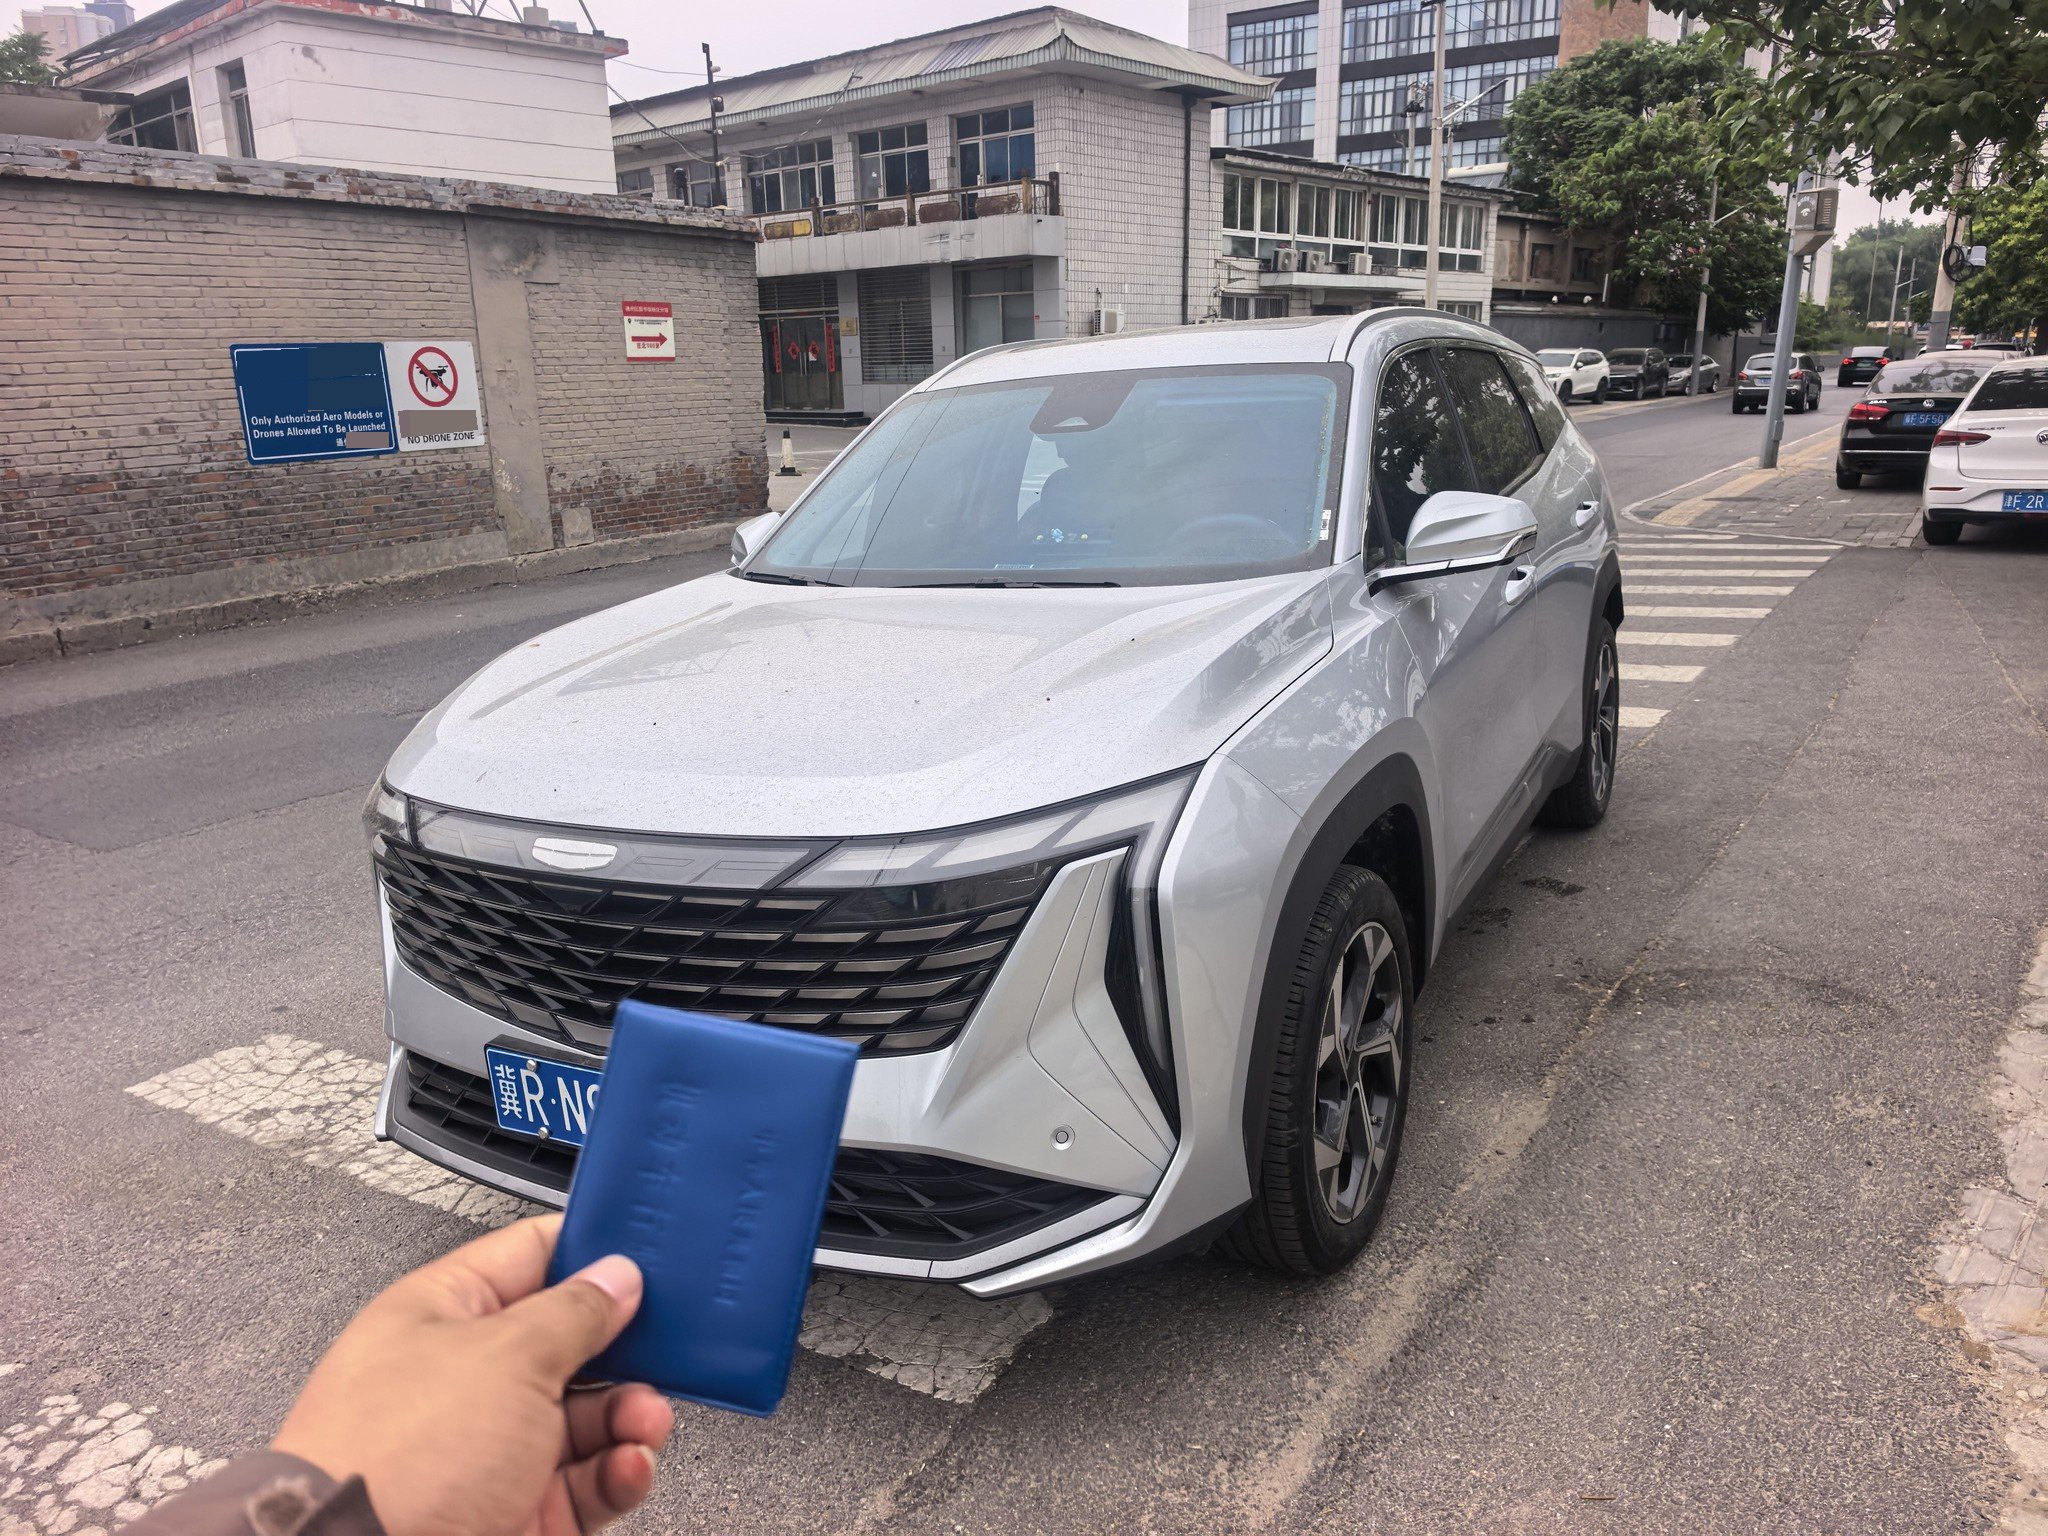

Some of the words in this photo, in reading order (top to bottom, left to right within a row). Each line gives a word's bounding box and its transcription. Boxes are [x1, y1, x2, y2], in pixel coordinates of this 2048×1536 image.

[251, 416, 271, 426] Only
[274, 413, 320, 424] Authorized
[323, 412, 342, 421] Aero
[344, 410, 373, 420] Models
[253, 428, 284, 439] Drones
[287, 426, 321, 437] Allowed
[323, 425, 334, 433] To
[336, 424, 346, 432] Be
[348, 422, 386, 432] Launched
[407, 436, 420, 444] NO
[423, 433, 451, 443] DRONE
[453, 432, 475, 441] ZONE
[2003, 494, 2048, 509] 津F·2R
